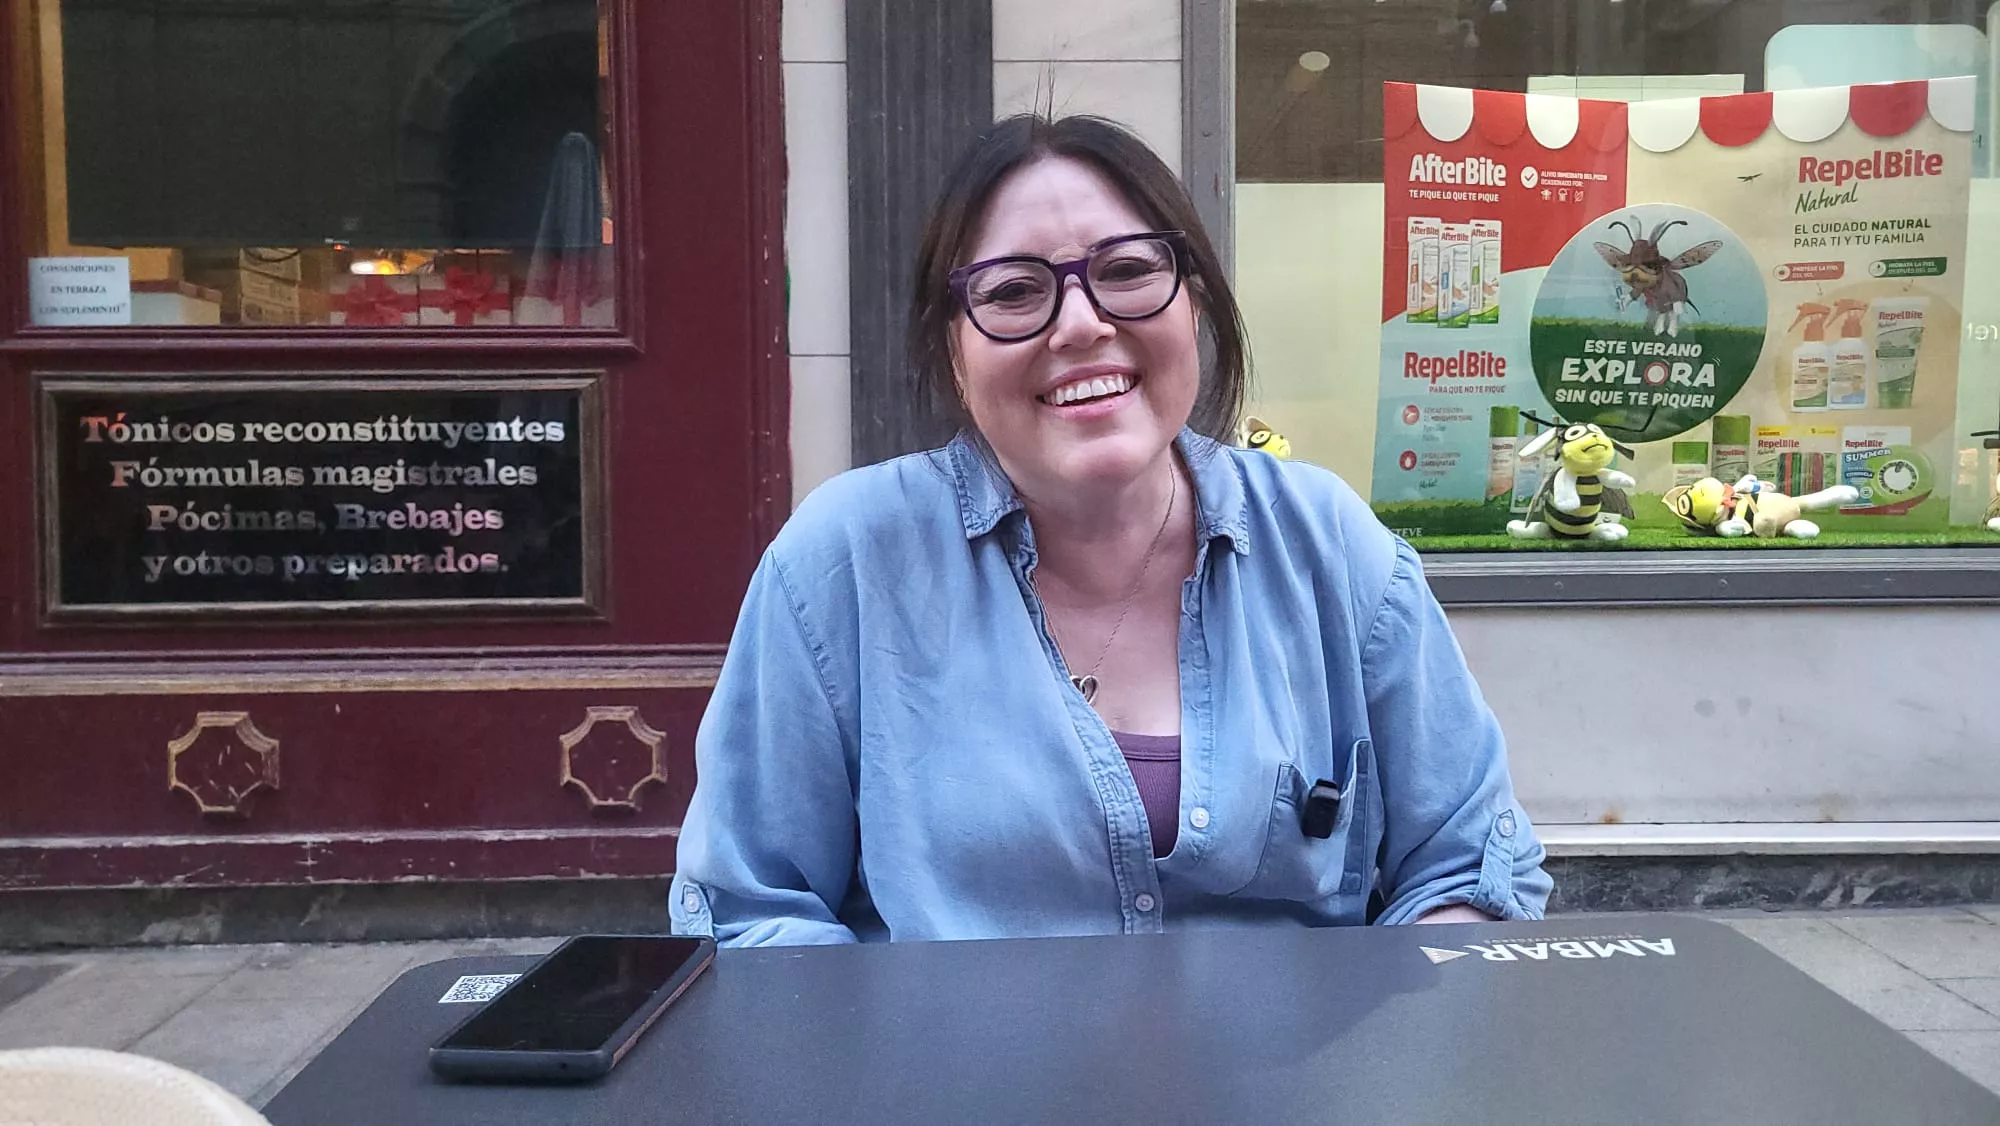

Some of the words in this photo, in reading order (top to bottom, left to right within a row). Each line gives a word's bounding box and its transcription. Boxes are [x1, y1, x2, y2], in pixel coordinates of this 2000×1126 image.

[1408, 153, 1507, 187] AfterBite
[1798, 148, 1943, 186] RepelBite
[1408, 189, 1418, 198] TE
[1420, 190, 1442, 200] PIQUE
[1442, 191, 1452, 200] LO
[1452, 191, 1467, 201] QUE
[1468, 192, 1477, 201] TE
[1478, 193, 1500, 203] PIQUE
[1794, 182, 1858, 214] Natural
[1794, 224, 1808, 235] EL
[1812, 221, 1868, 234] CUIDADO
[1871, 218, 1931, 231] NATURAL
[1794, 237, 1827, 248] PARA
[1831, 236, 1840, 246] TI
[1842, 235, 1852, 246] Y
[1855, 235, 1870, 245] TU
[1874, 232, 1924, 245] FAMILIA
[51, 286, 62, 294] EN
[66, 286, 106, 294] TERRAZA
[1584, 339, 1627, 354] ESTE
[1631, 341, 1702, 358] VERANO
[1404, 350, 1506, 384] RepelBite
[1560, 356, 1716, 388] EXPLORA
[1448, 386, 1463, 394] QUE
[1484, 385, 1506, 394] PIQUE
[1554, 388, 1586, 403] SIN
[1588, 390, 1624, 406] QUE
[1628, 392, 1648, 405] TE
[1651, 392, 1715, 409] PIQUEN
[80, 412, 236, 443] Tónicos
[242, 414, 566, 446] reconstituyentes
[1758, 438, 1800, 449] RepelBite
[1845, 440, 1884, 448] RepelBite
[110, 456, 304, 488] Fórmulas
[312, 456, 538, 494] magistrales
[146, 500, 327, 535] Pócimas,
[333, 502, 504, 536] Brebajes
[142, 555, 168, 583] y
[172, 550, 275, 576] otros
[281, 546, 510, 583] preparados.
[1463, 937, 1677, 962] AMBAR
